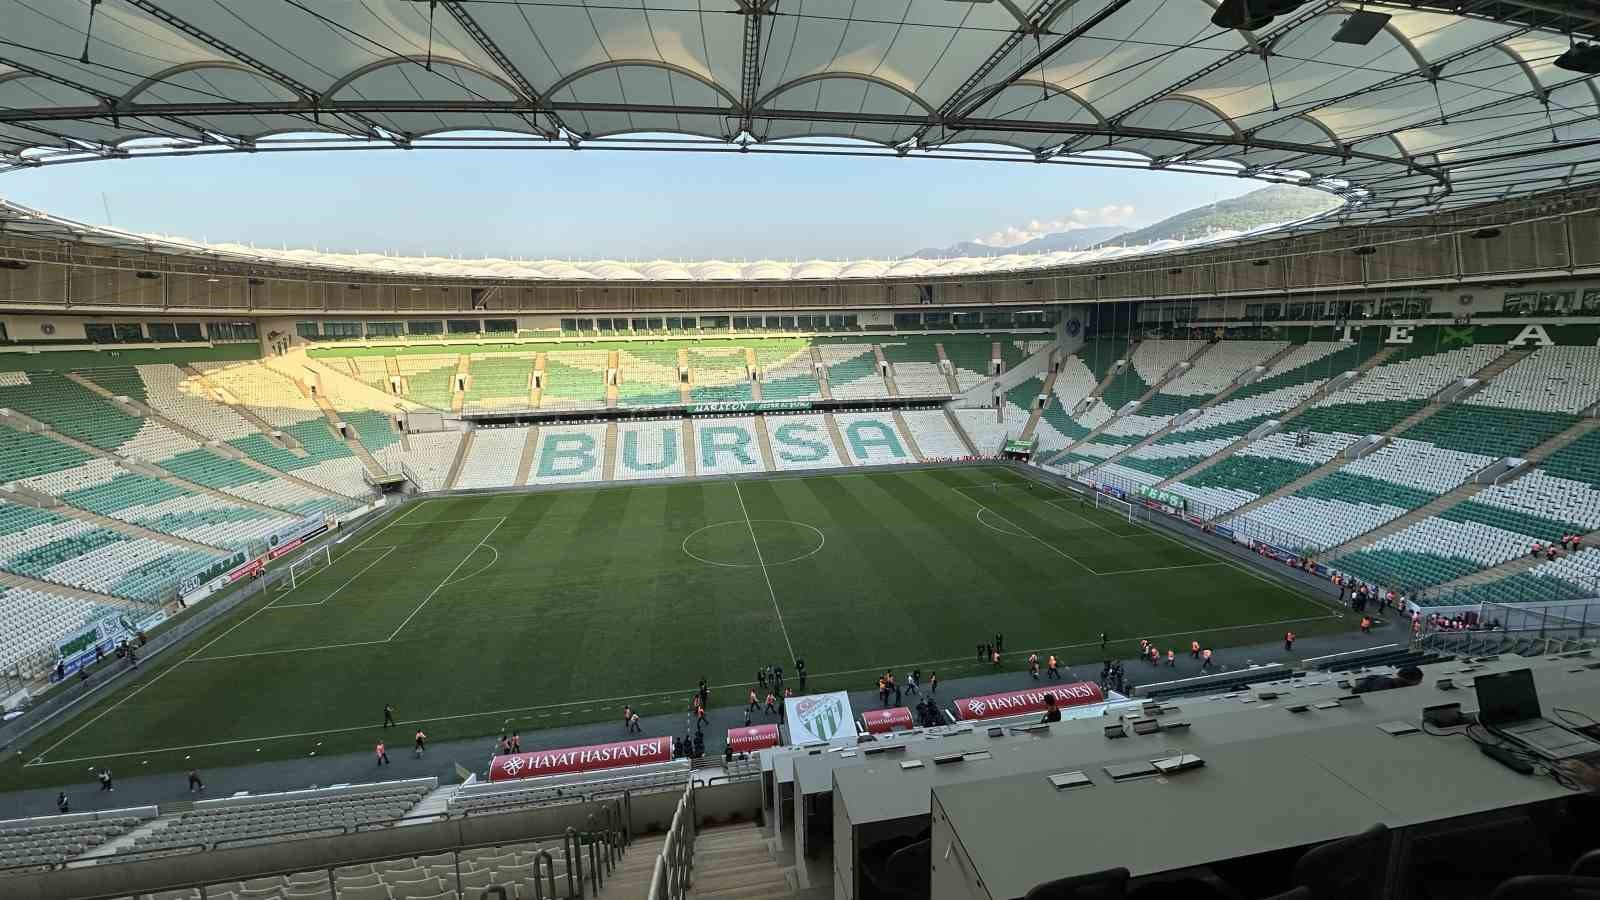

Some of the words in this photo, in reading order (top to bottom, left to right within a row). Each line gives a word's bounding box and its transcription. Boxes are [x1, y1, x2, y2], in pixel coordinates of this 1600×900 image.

[536, 419, 906, 478] BURSA
[987, 694, 1026, 711] HAYAT
[1027, 683, 1095, 704] HATANESİ
[527, 751, 578, 770] HAYAT
